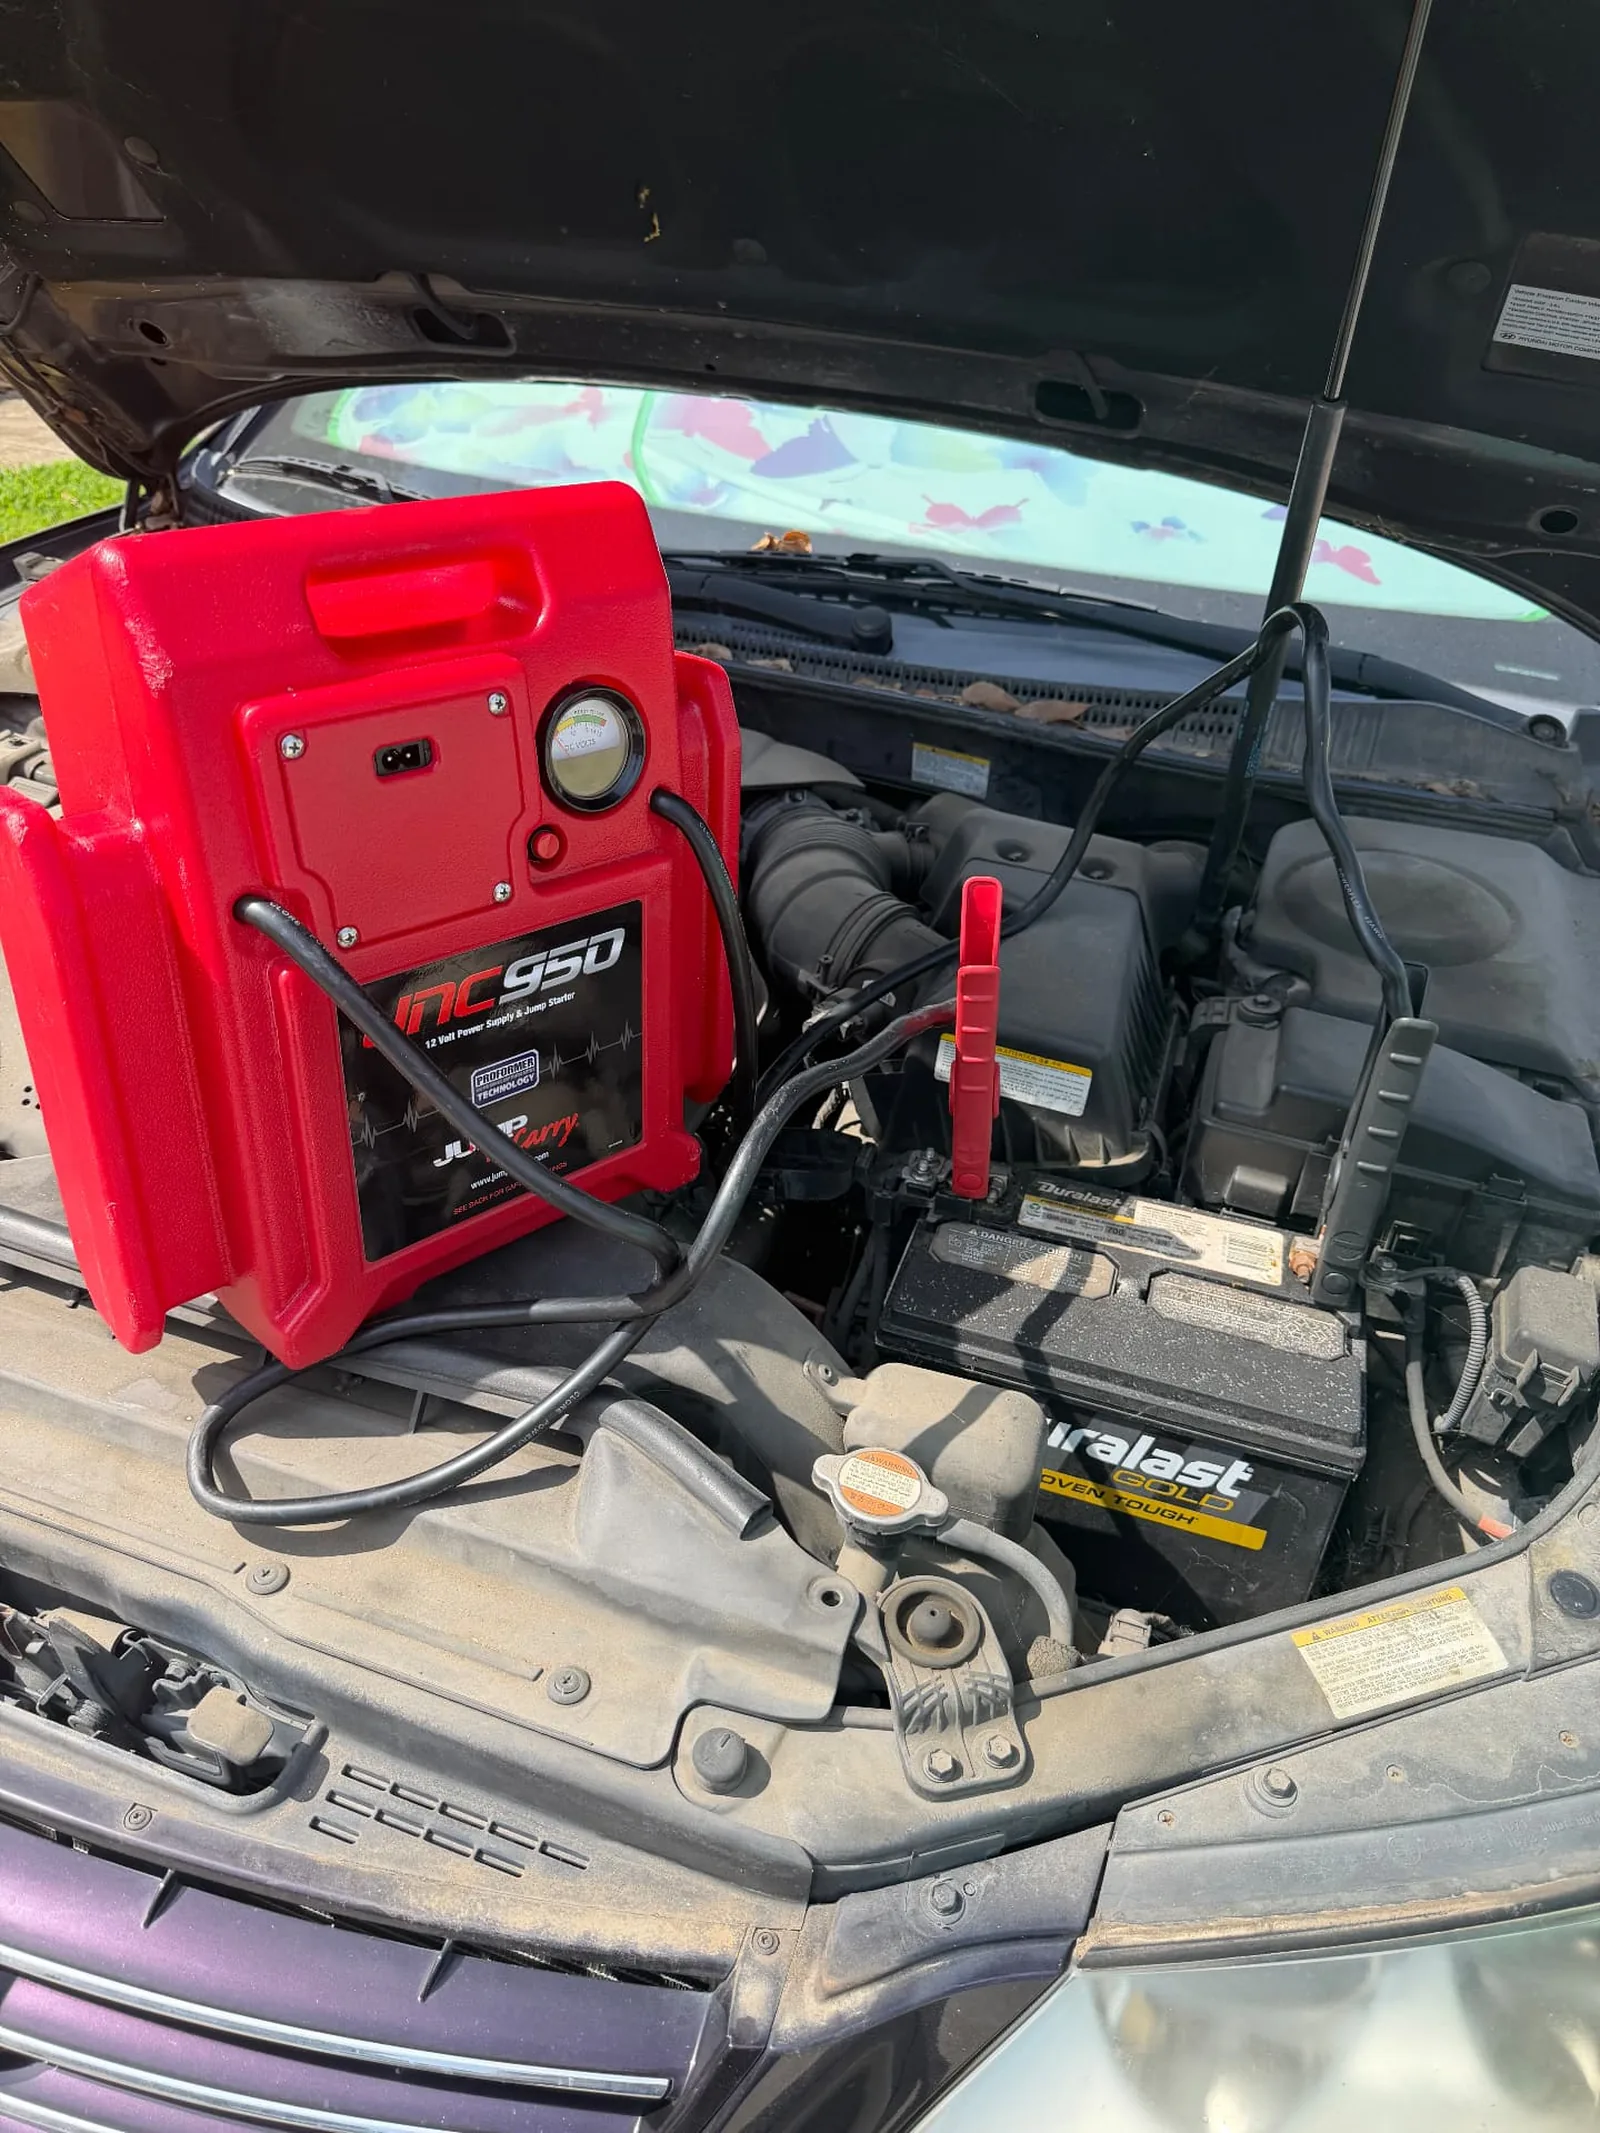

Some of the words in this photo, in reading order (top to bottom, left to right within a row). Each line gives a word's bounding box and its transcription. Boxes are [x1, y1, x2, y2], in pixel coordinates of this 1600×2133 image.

[425, 1039, 438, 1049] 12
[439, 1031, 456, 1047] Volt
[457, 1023, 485, 1039] Power
[486, 1012, 514, 1032] Supply
[516, 1009, 523, 1019] &
[524, 1000, 547, 1016] Jump
[548, 991, 576, 1008] Starter
[477, 1058, 534, 1086] PROFORMER
[477, 1073, 535, 1101] TECHNOLOGY
[1038, 1181, 1123, 1209] Duralast
[1107, 1226, 1125, 1236] 700
[980, 1231, 1028, 1249] DANGER
[1039, 1245, 1083, 1262] POISON
[1040, 1473, 1106, 1500] OVEN
[1112, 1494, 1194, 1526] TOUGH
[1112, 1468, 1235, 1513] GOLD
